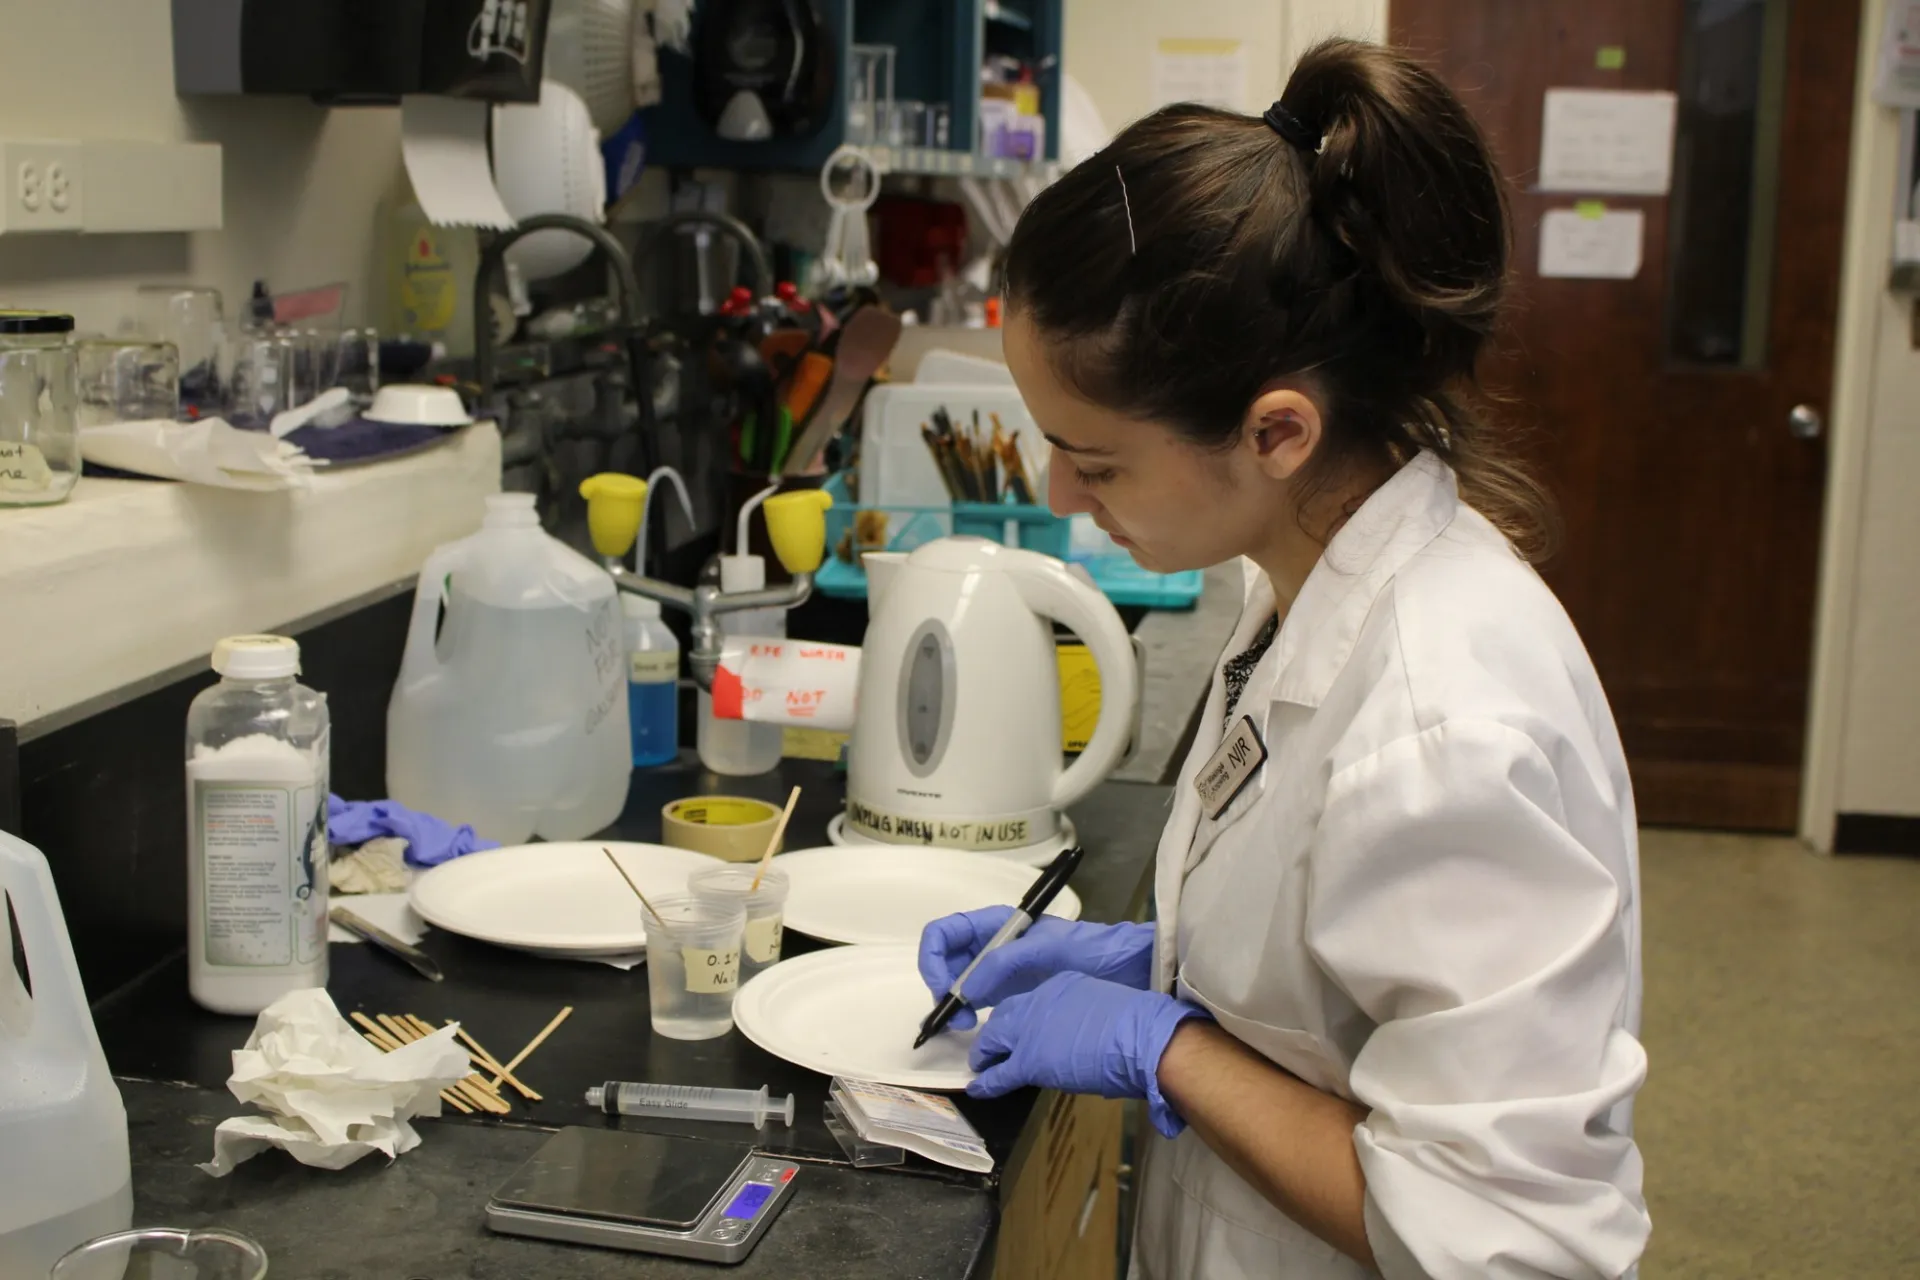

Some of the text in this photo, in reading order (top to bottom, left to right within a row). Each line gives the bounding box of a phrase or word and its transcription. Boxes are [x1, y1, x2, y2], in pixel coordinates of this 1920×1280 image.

[786, 689, 827, 705] NOT
[1226, 736, 1251, 769] NJR
[975, 825, 995, 844] IN
[998, 820, 1028, 842] USE
[639, 1097, 688, 1110] Easy Glide
